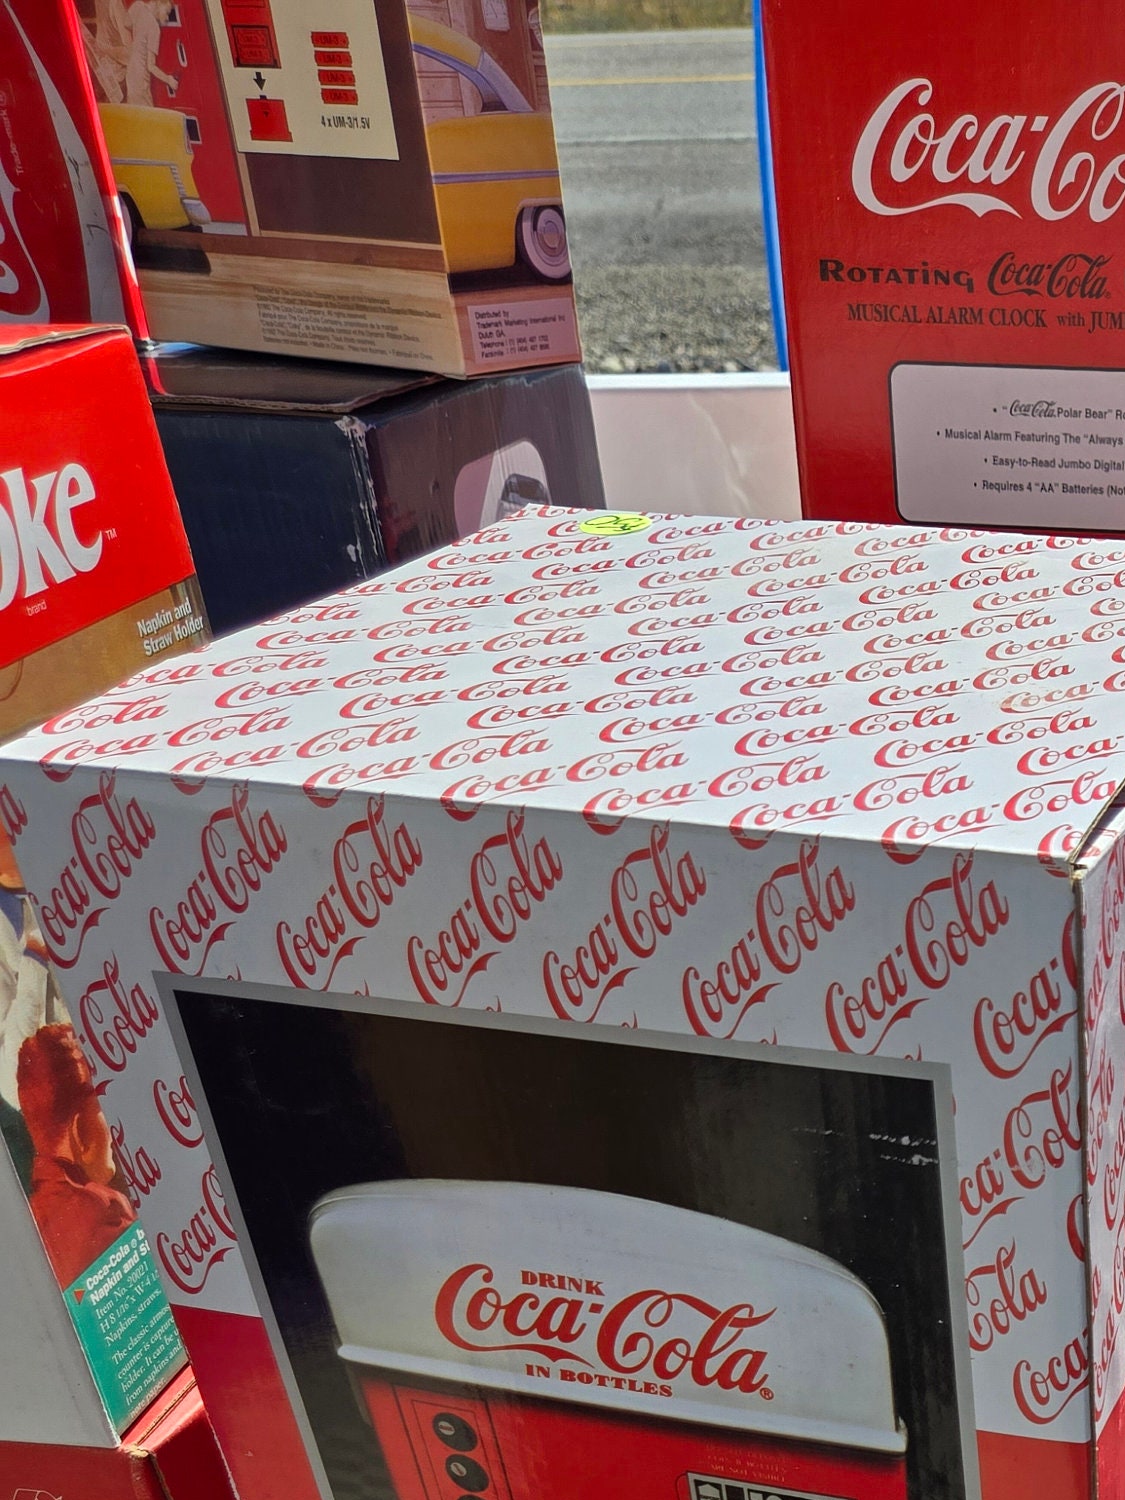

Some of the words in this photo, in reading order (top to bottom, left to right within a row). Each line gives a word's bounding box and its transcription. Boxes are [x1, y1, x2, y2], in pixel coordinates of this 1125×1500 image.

[321, 115, 326, 127] 4
[987, 251, 1114, 299] Coca-Cola
[847, 303, 922, 324] MUSICAL
[926, 305, 984, 326] ALARM
[988, 307, 1048, 328] CLOCK
[1056, 311, 1086, 328] with
[1057, 407, 1082, 420] Polar
[944, 428, 982, 441] Musical
[983, 430, 1012, 442] Alarm
[1014, 430, 1060, 446] Featuring
[1062, 432, 1081, 444] The
[992, 455, 1056, 469] Easy-to-Read
[1058, 458, 1092, 470] Jumbo
[1094, 459, 1125, 473] Digital
[982, 480, 1025, 494] Requires
[1026, 481, 1033, 493] 4
[1062, 483, 1104, 496] Batteries
[427, 535, 613, 573] Coca-Cola
[532, 543, 716, 582] Coca-Cola
[638, 550, 820, 590] Coca-Cola
[747, 555, 929, 599] Coca-Cola
[402, 577, 602, 616] Coca-Cola
[513, 587, 712, 627] Coca-Cola
[859, 562, 1039, 606] Coca-Cola
[26, 600, 48, 617] brand
[136, 608, 173, 638] Napkin
[174, 596, 192, 618] and
[627, 597, 823, 638] Coca-Cola
[743, 603, 938, 647] Coca-Cola
[863, 608, 1057, 655] Coca-Cola
[143, 634, 174, 657] Straw
[173, 614, 204, 642] Holder
[256, 613, 476, 651] Coca-Cola
[373, 623, 588, 663] Coca-Cola
[492, 634, 705, 675] Coca-Cola
[214, 660, 451, 709] Coca-Cola
[613, 644, 825, 687] Coca-Cola
[740, 652, 948, 698] Coca-Cola
[868, 658, 1076, 707] Coca-Cola
[339, 672, 573, 720] Coca-Cola
[466, 685, 698, 733] Coca-Cola
[598, 696, 826, 744] Coca-Cola
[734, 701, 960, 756] Coca-Cola
[873, 707, 1097, 770] Coca-Cola
[41, 707, 296, 783] Coca-Cola
[170, 714, 423, 796] Coca-Cola
[302, 726, 553, 808] Coca-Cola
[440, 740, 691, 820] Coca-Cola
[582, 753, 830, 834] Coca-Cola
[730, 762, 974, 851] Coca-Cola
[881, 767, 1119, 866] Coca-Cola
[35, 766, 156, 970] Coca-Cola
[149, 777, 288, 976] Coca-Cola
[276, 789, 424, 991] Coca-Cola
[407, 805, 564, 1007] Coca-Cola
[542, 818, 708, 1022] Coca-Cola
[682, 831, 857, 1038] Coca-Cola
[825, 846, 1011, 1053] Coca-Cola
[86, 1243, 131, 1290] Coca-Cola
[90, 1269, 123, 1306] Napkin
[122, 1250, 140, 1274] and
[520, 1269, 605, 1296] DRINK
[95, 1300, 114, 1320] Item
[434, 1263, 778, 1394] Coca-Cola
[111, 1347, 128, 1366] The
[127, 1324, 150, 1351] classic
[117, 1348, 143, 1380] counter
[125, 1385, 143, 1406] from
[143, 1357, 170, 1387] napkins
[525, 1363, 551, 1379] IN
[560, 1369, 673, 1398] BOTTLES
